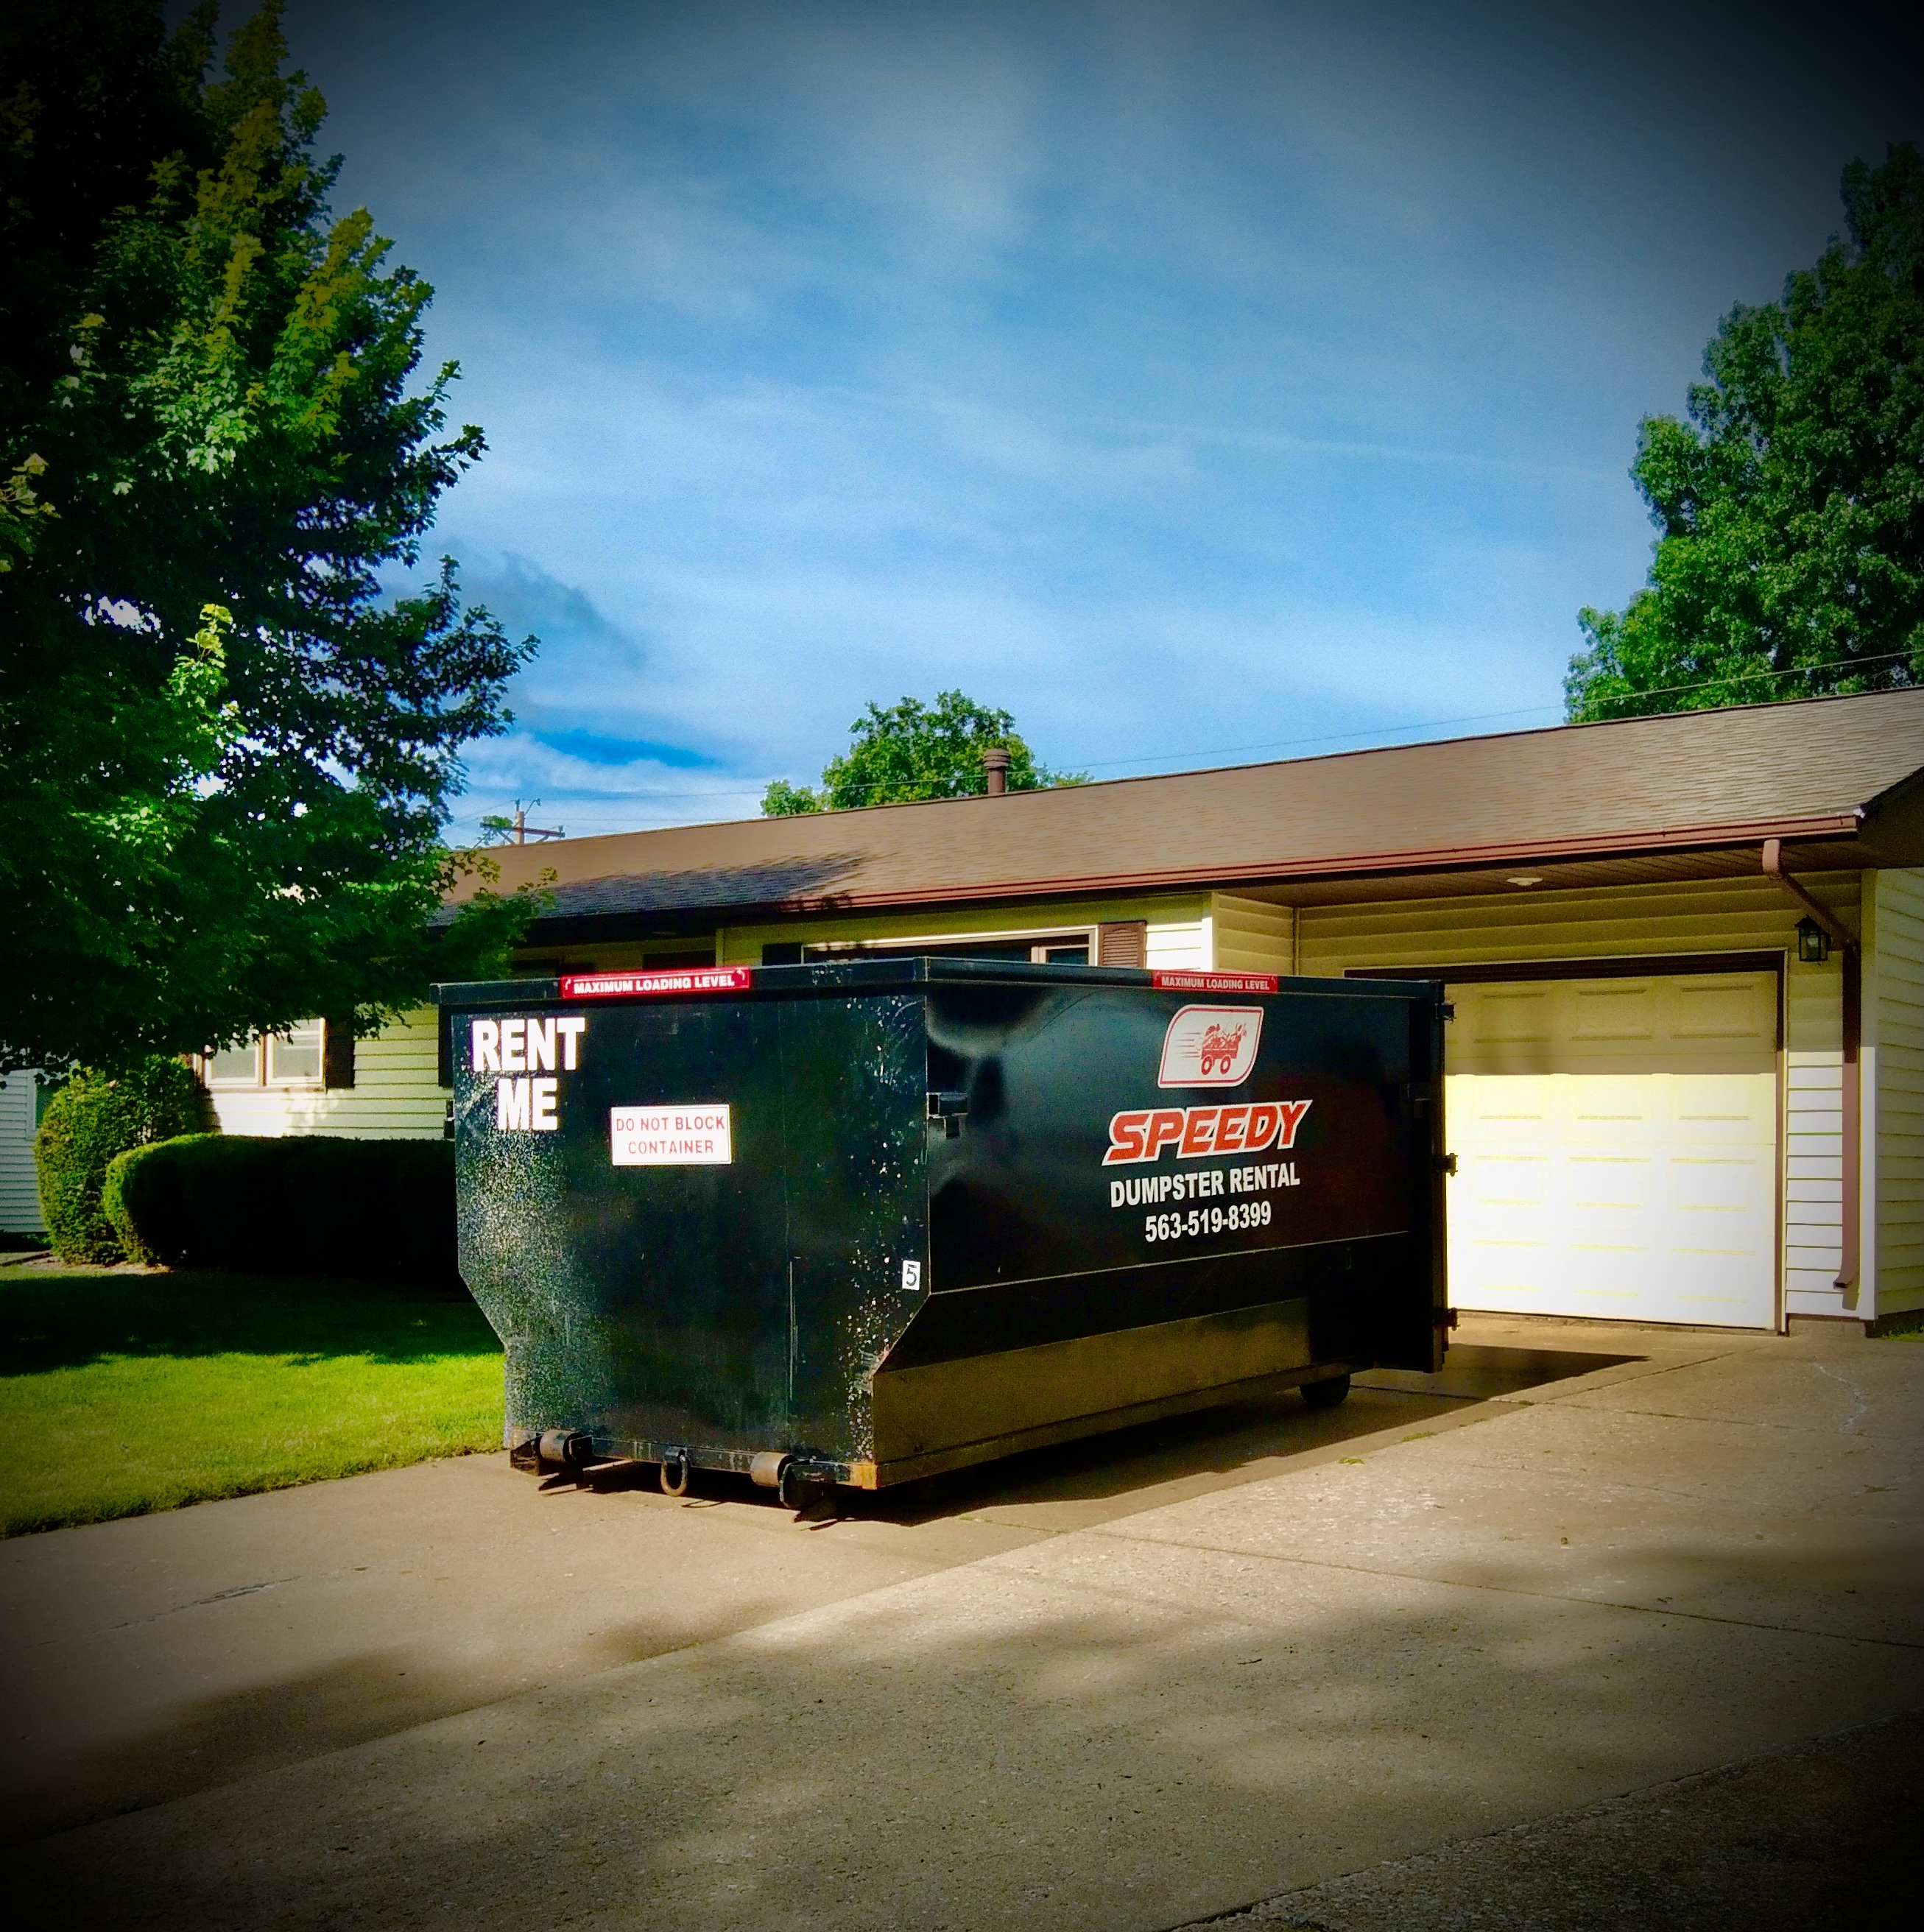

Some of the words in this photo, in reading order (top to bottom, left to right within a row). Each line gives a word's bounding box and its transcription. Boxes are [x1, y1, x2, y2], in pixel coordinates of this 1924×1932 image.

[574, 981, 633, 994] MAXIMUM
[635, 977, 692, 991] LOADING
[694, 975, 735, 987] LEVEL
[1161, 976, 1205, 987] MAXIMUM
[1206, 979, 1243, 989] LOADING
[1245, 980, 1270, 990] LEVEL
[472, 1017, 585, 1071] RENT
[497, 1078, 560, 1131] ME
[616, 1118, 635, 1132] DO
[641, 1117, 669, 1131] NOT
[675, 1115, 725, 1130] BLOCK
[1102, 1099, 1313, 1166] SPEEDY
[628, 1140, 713, 1154] CONTAINER
[1110, 1170, 1224, 1208] DUMPSTER
[1230, 1162, 1300, 1194] RENTAL
[1145, 1200, 1272, 1242] 563-519-8399
[906, 1263, 917, 1286] 5
